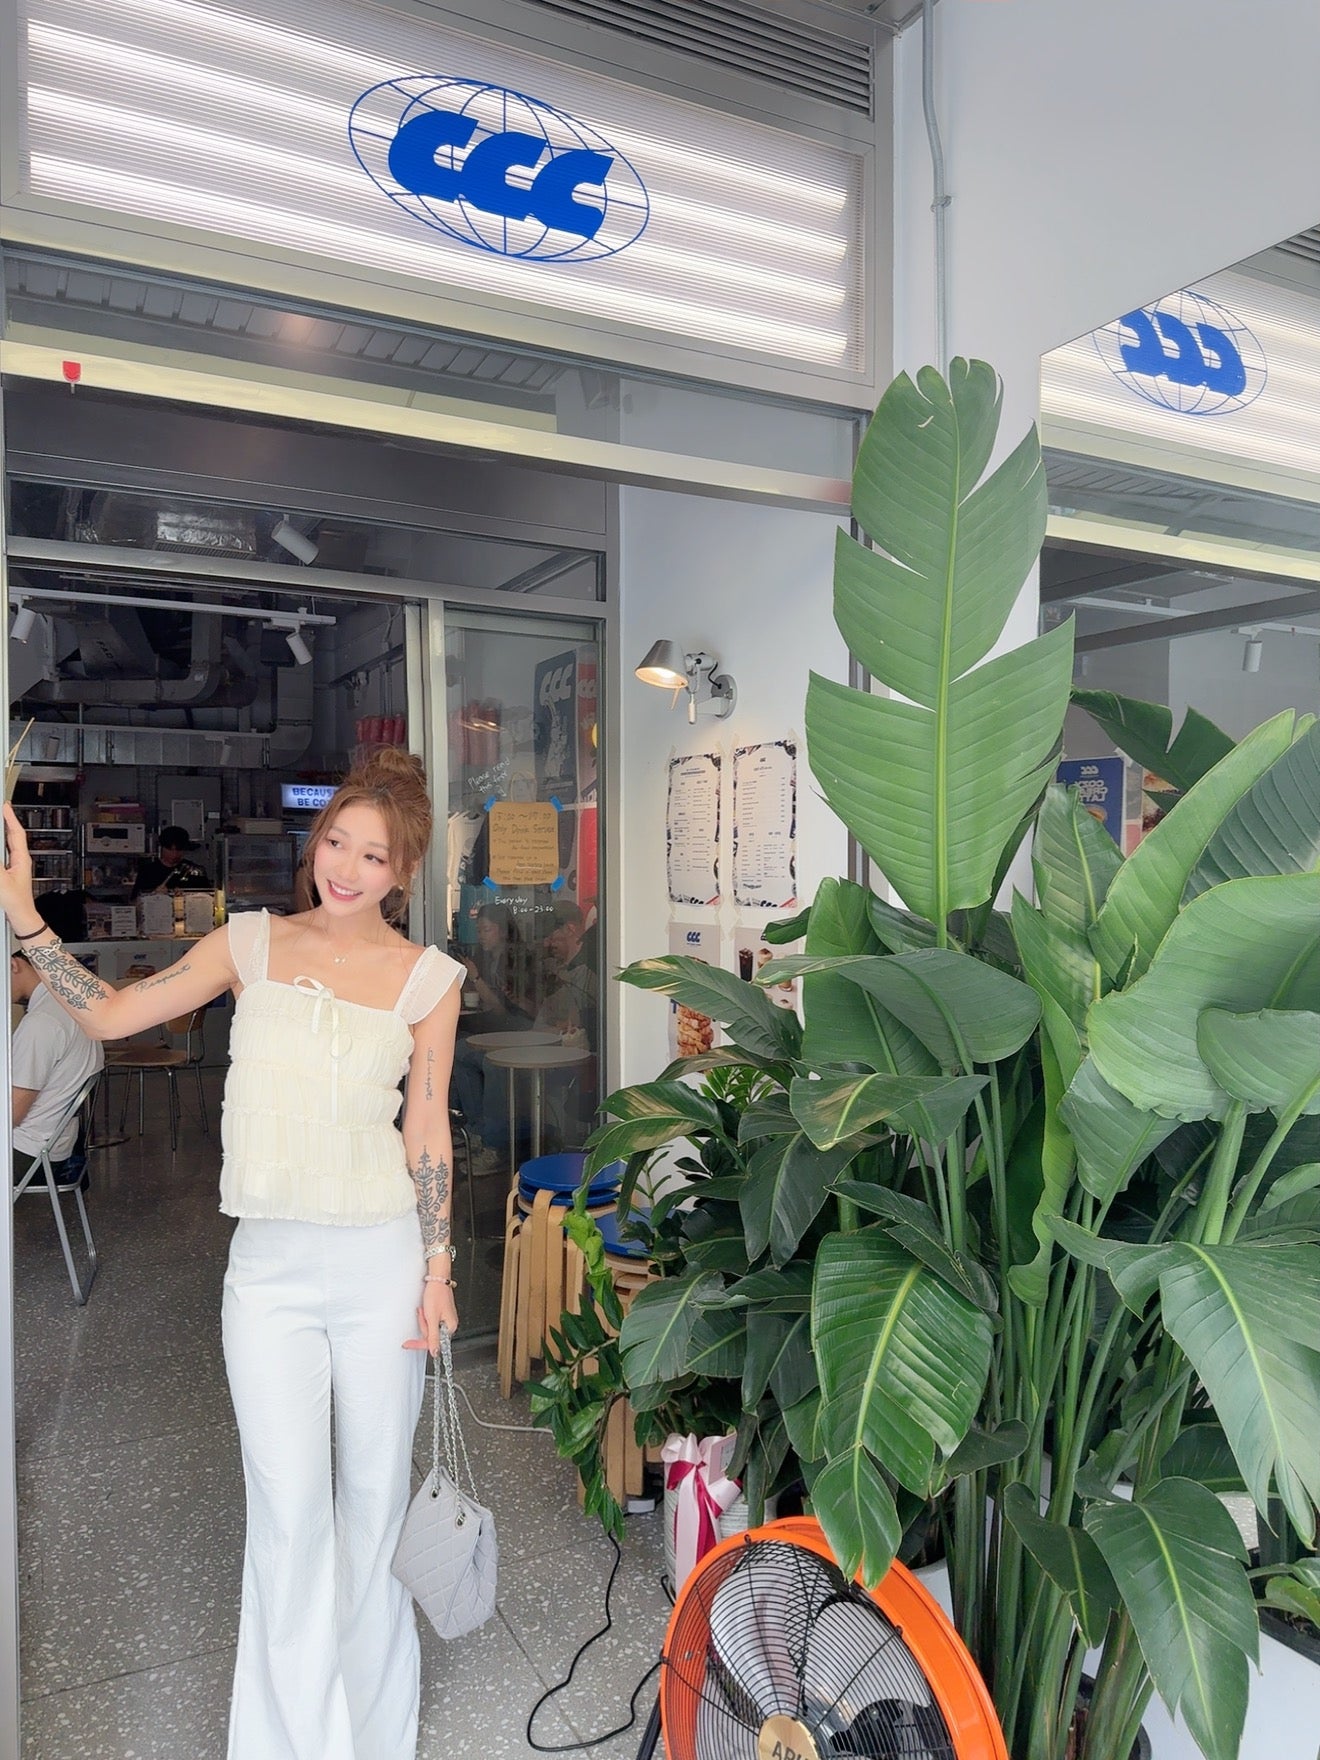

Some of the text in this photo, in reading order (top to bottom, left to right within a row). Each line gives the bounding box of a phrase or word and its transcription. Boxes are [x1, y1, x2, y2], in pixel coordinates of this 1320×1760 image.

[388, 109, 613, 240] CCC
[540, 663, 574, 706] CCC
[292, 787, 334, 797] BECAUS
[297, 798, 328, 807] BE CO
[686, 931, 701, 943] CCC
